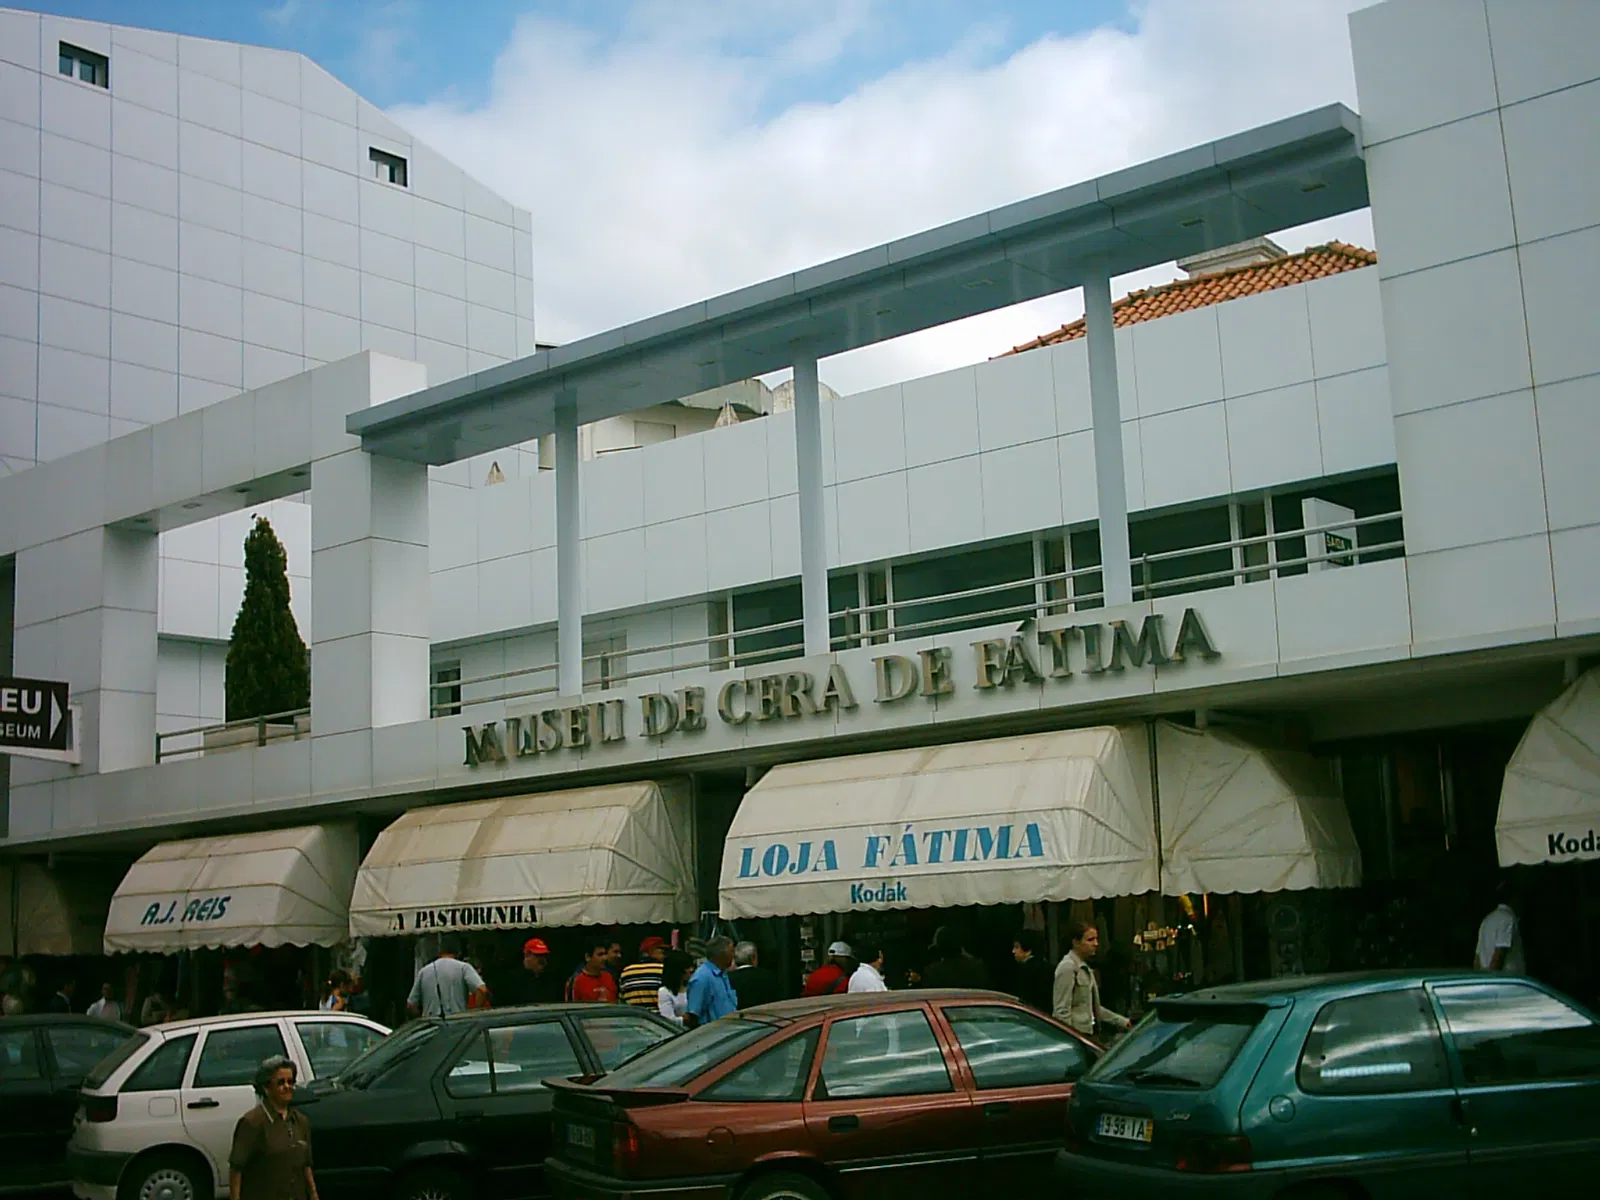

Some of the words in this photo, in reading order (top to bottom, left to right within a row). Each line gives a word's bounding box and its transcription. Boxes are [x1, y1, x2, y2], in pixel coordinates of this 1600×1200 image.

[462, 698, 626, 767] MUSEU
[639, 686, 707, 738] DE
[717, 663, 859, 726] CERA
[871, 646, 953, 703] DE
[970, 608, 1222, 691] FÁTIMA
[736, 840, 839, 879] LOJA
[860, 823, 1044, 868] FÁTIMA
[851, 881, 907, 904] Kodak
[140, 900, 178, 925] A.J.
[180, 896, 232, 922] REIS
[414, 904, 538, 929] PASTORINHA
